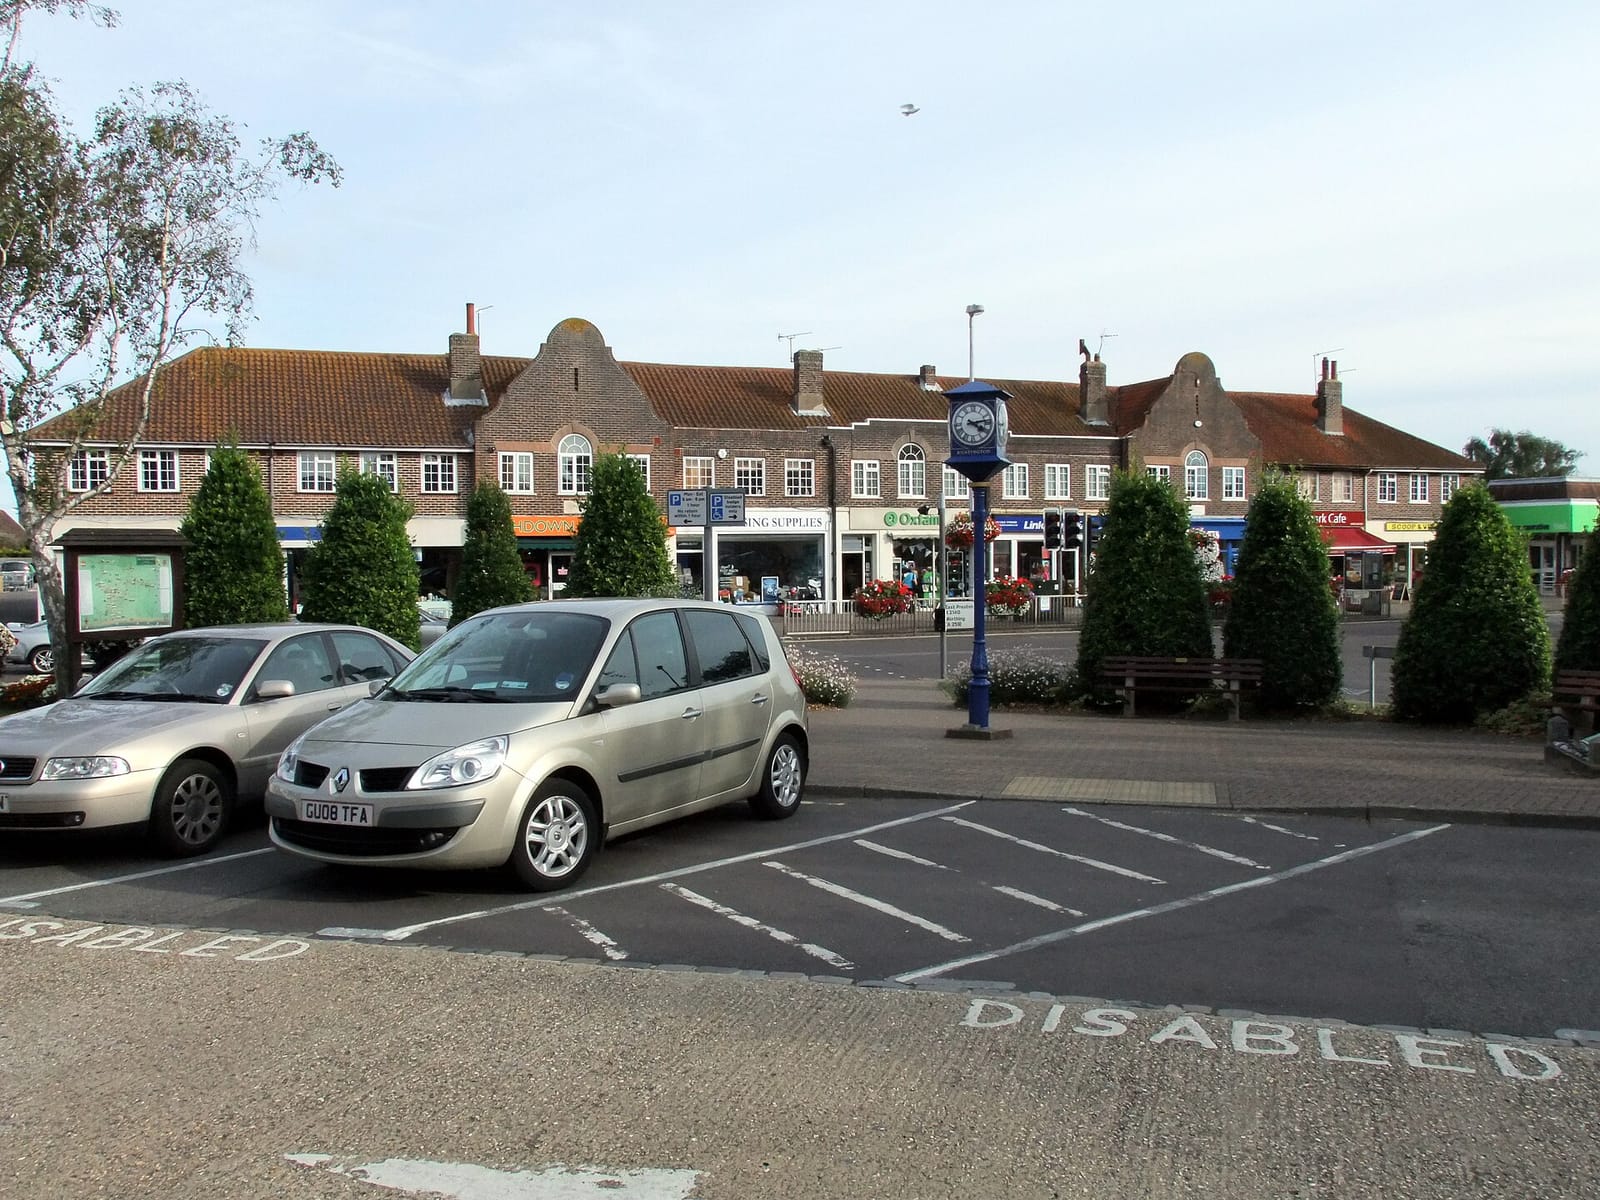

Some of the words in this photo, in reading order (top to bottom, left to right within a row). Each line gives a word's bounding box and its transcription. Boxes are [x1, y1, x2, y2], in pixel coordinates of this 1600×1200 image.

[744, 517, 769, 528] SING
[771, 517, 822, 528] SUPPLIES
[1328, 512, 1347, 524] Cafe
[513, 519, 575, 533] HDOWN
[1023, 520, 1046, 530] Link
[342, 806, 368, 823] TFA
[957, 997, 1563, 1083] DISABLED
